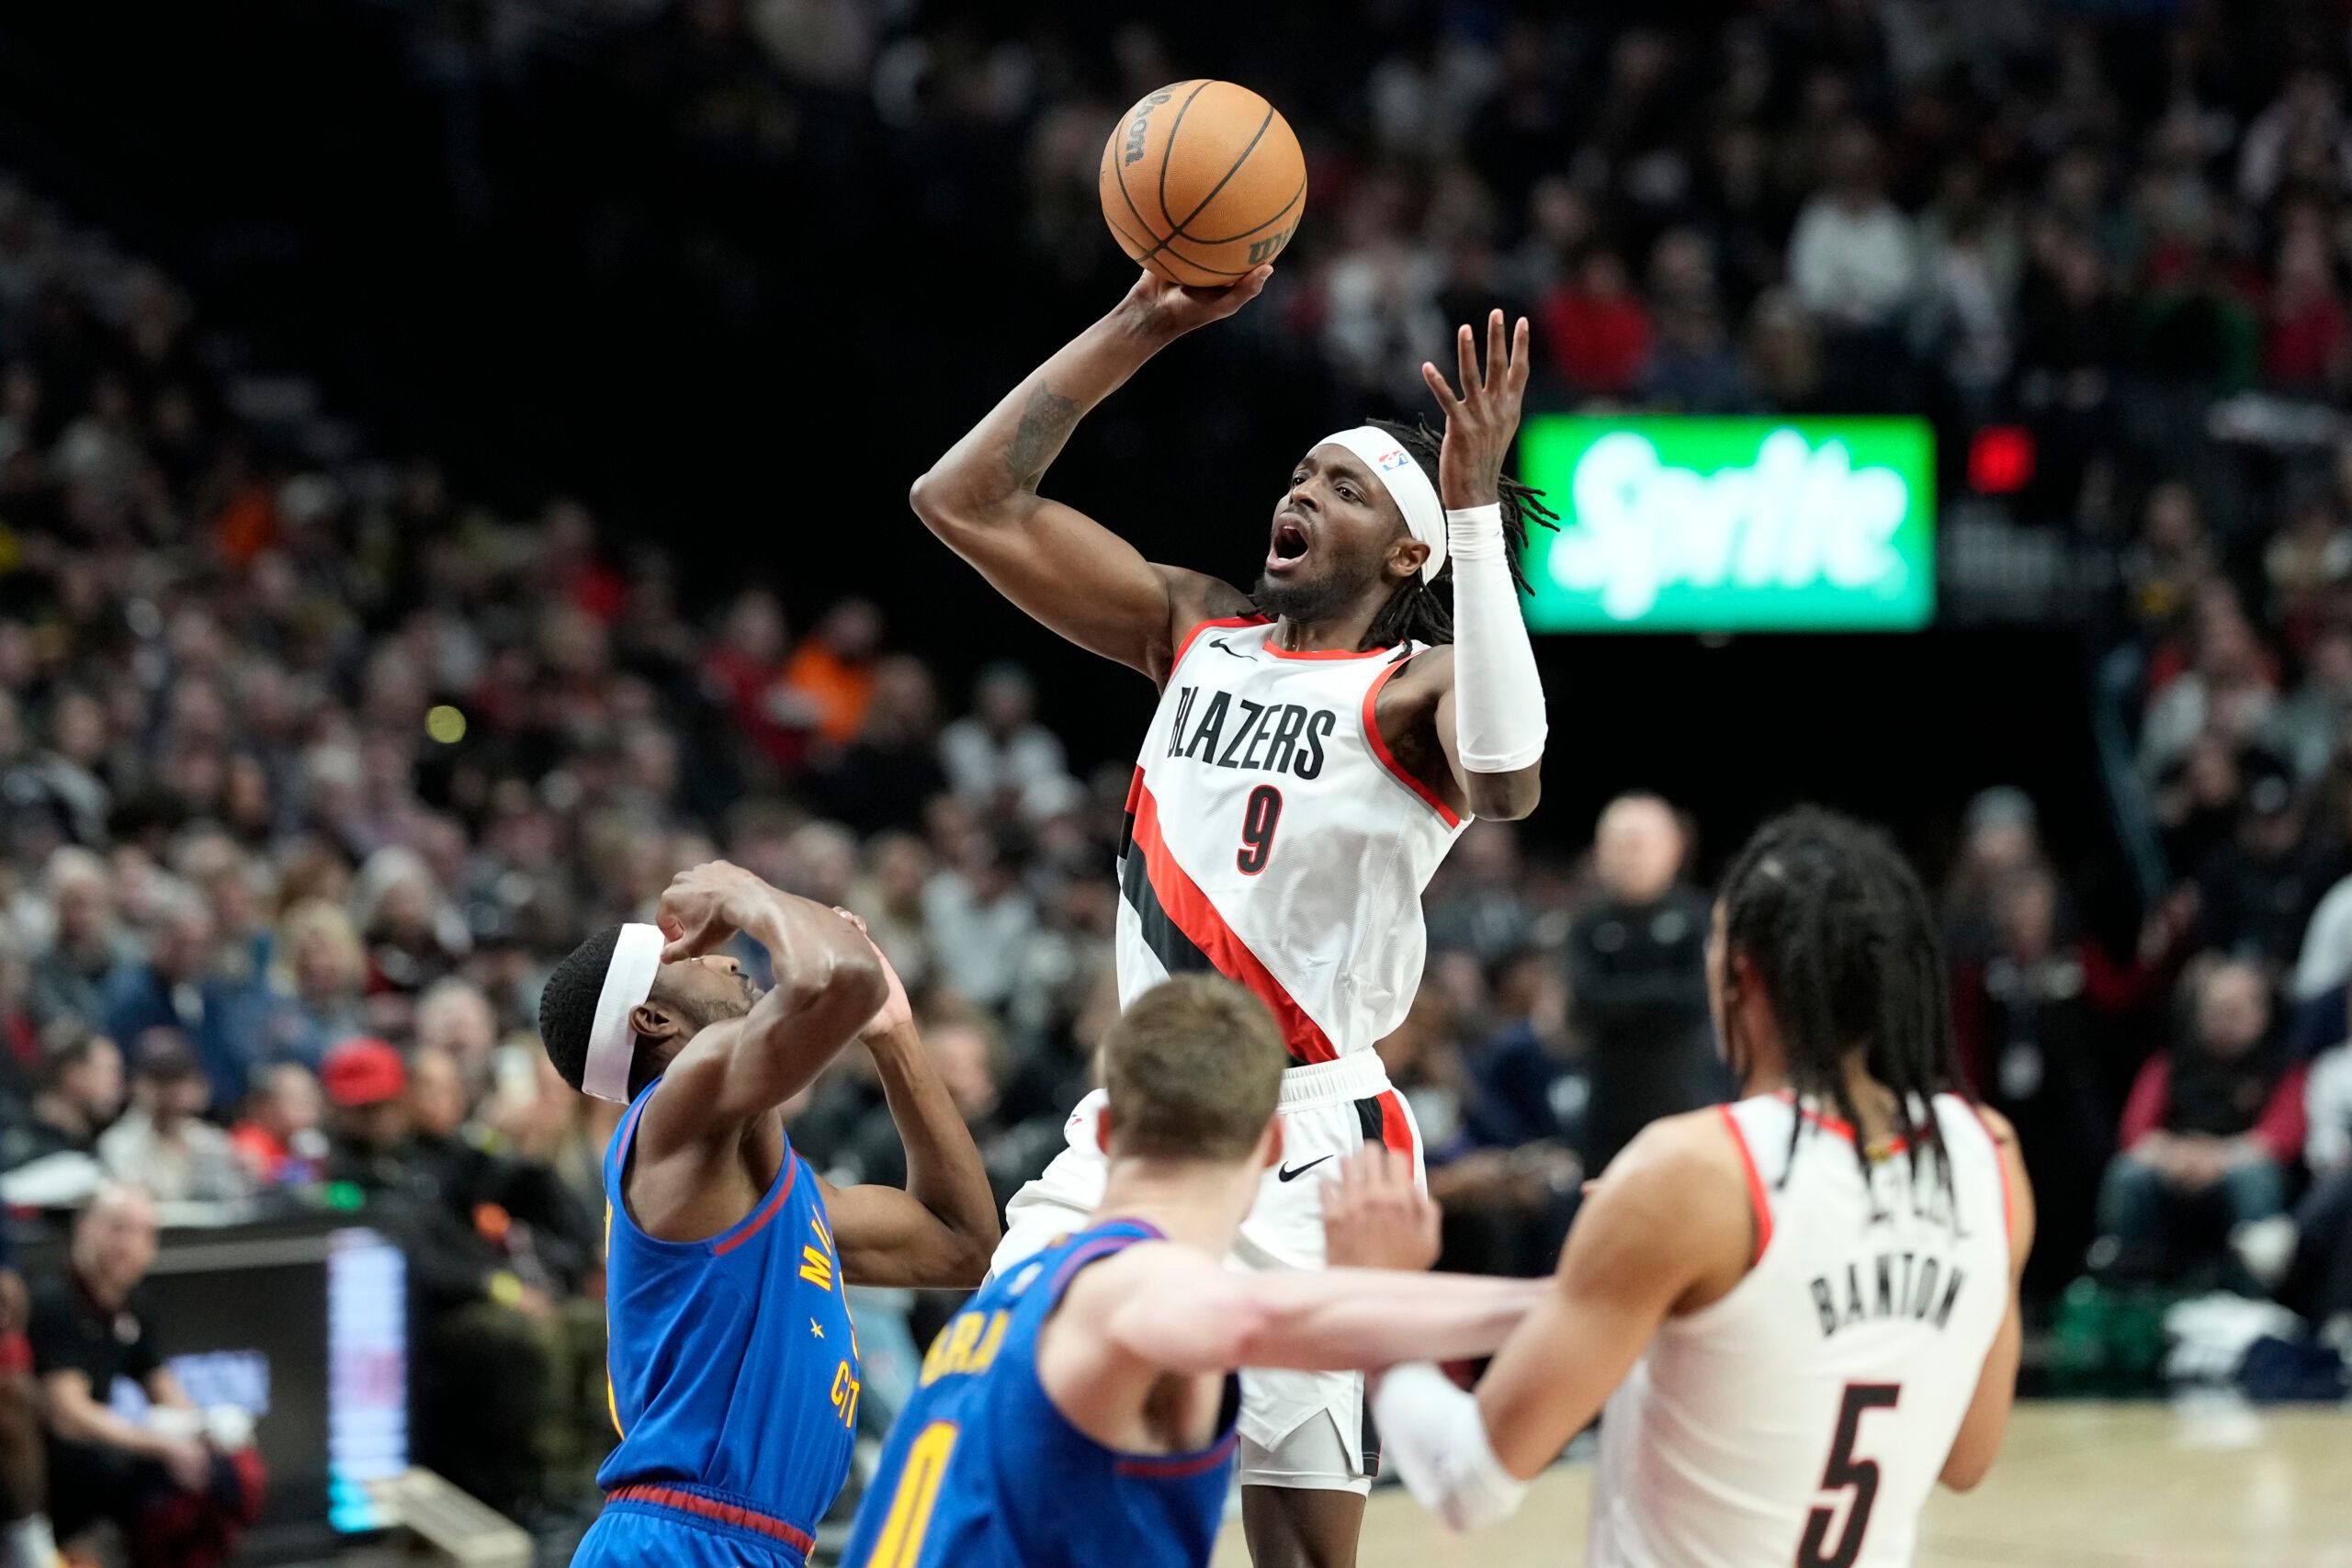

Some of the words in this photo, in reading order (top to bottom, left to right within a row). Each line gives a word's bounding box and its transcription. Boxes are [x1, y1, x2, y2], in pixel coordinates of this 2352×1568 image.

[1548, 427, 1908, 621] Sprite
[1167, 686, 1336, 780] BLAZERS
[1237, 784, 1283, 875] 9
[1810, 1252, 1965, 1337] BANTON
[1796, 1383, 1901, 1568] 5
